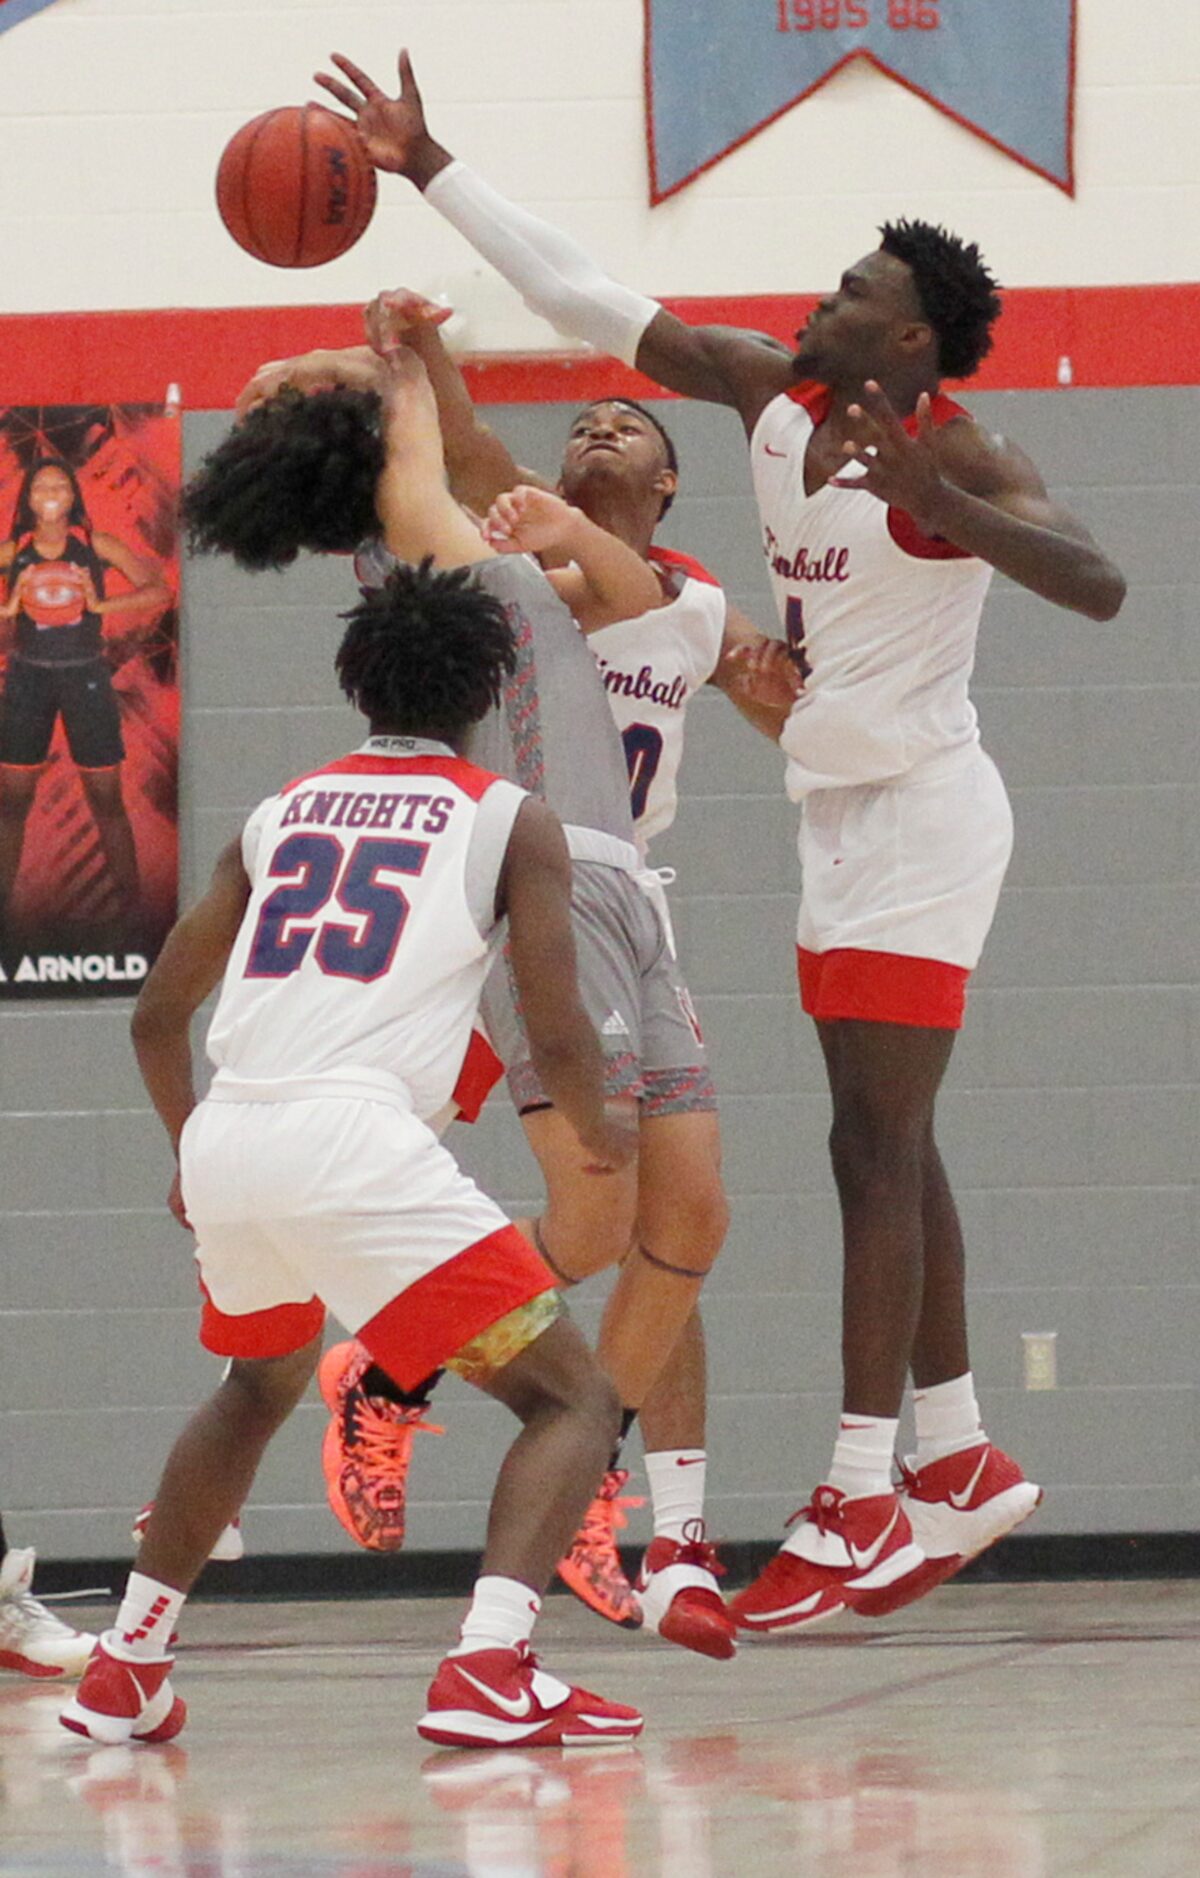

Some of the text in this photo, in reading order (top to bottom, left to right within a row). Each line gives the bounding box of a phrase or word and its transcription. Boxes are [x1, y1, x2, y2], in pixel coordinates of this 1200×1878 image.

[776, 0, 939, 33] 1985 86
[596, 654, 687, 709] imball
[279, 791, 455, 834] KNIGHTS
[242, 832, 431, 984] 25
[14, 954, 148, 982] ARNOLD
